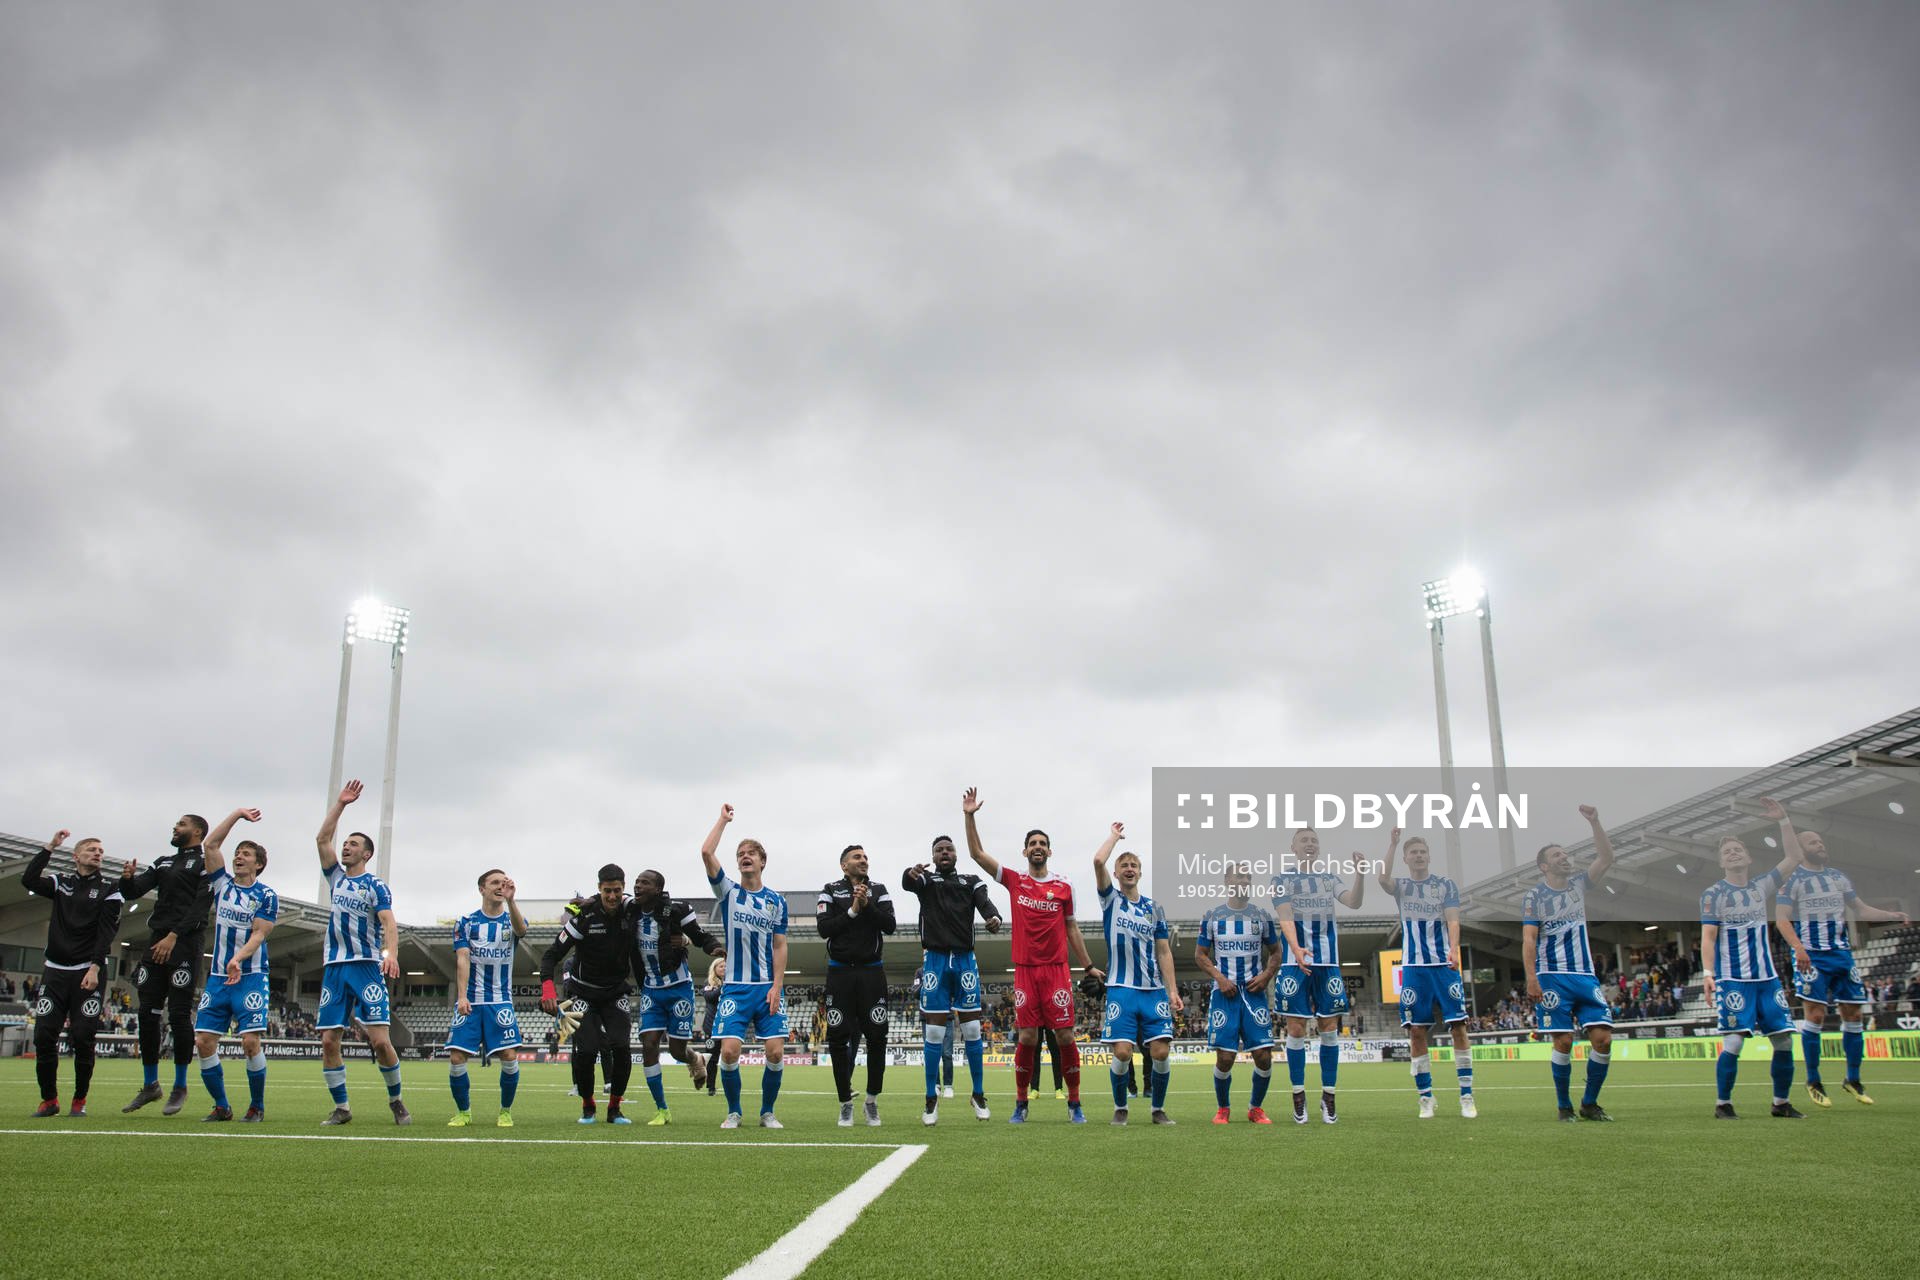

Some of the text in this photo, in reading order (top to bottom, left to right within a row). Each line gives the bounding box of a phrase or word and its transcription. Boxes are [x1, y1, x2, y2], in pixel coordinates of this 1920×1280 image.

[1017, 895, 1059, 912] SERNEKE
[218, 908, 254, 923] SERNEK
[733, 911, 775, 930] SERNEKE
[1116, 916, 1153, 936] SERNEK
[1218, 941, 1260, 951] SERNEKE
[470, 947, 511, 958] SERNEKE
[966, 993, 976, 1003] 27
[1333, 999, 1345, 1007] 24
[370, 1007, 382, 1016] 22
[1063, 1007, 1070, 1017] 1
[252, 1013, 263, 1023] 29
[678, 1021, 690, 1030] 28
[503, 1029, 515, 1039] 10
